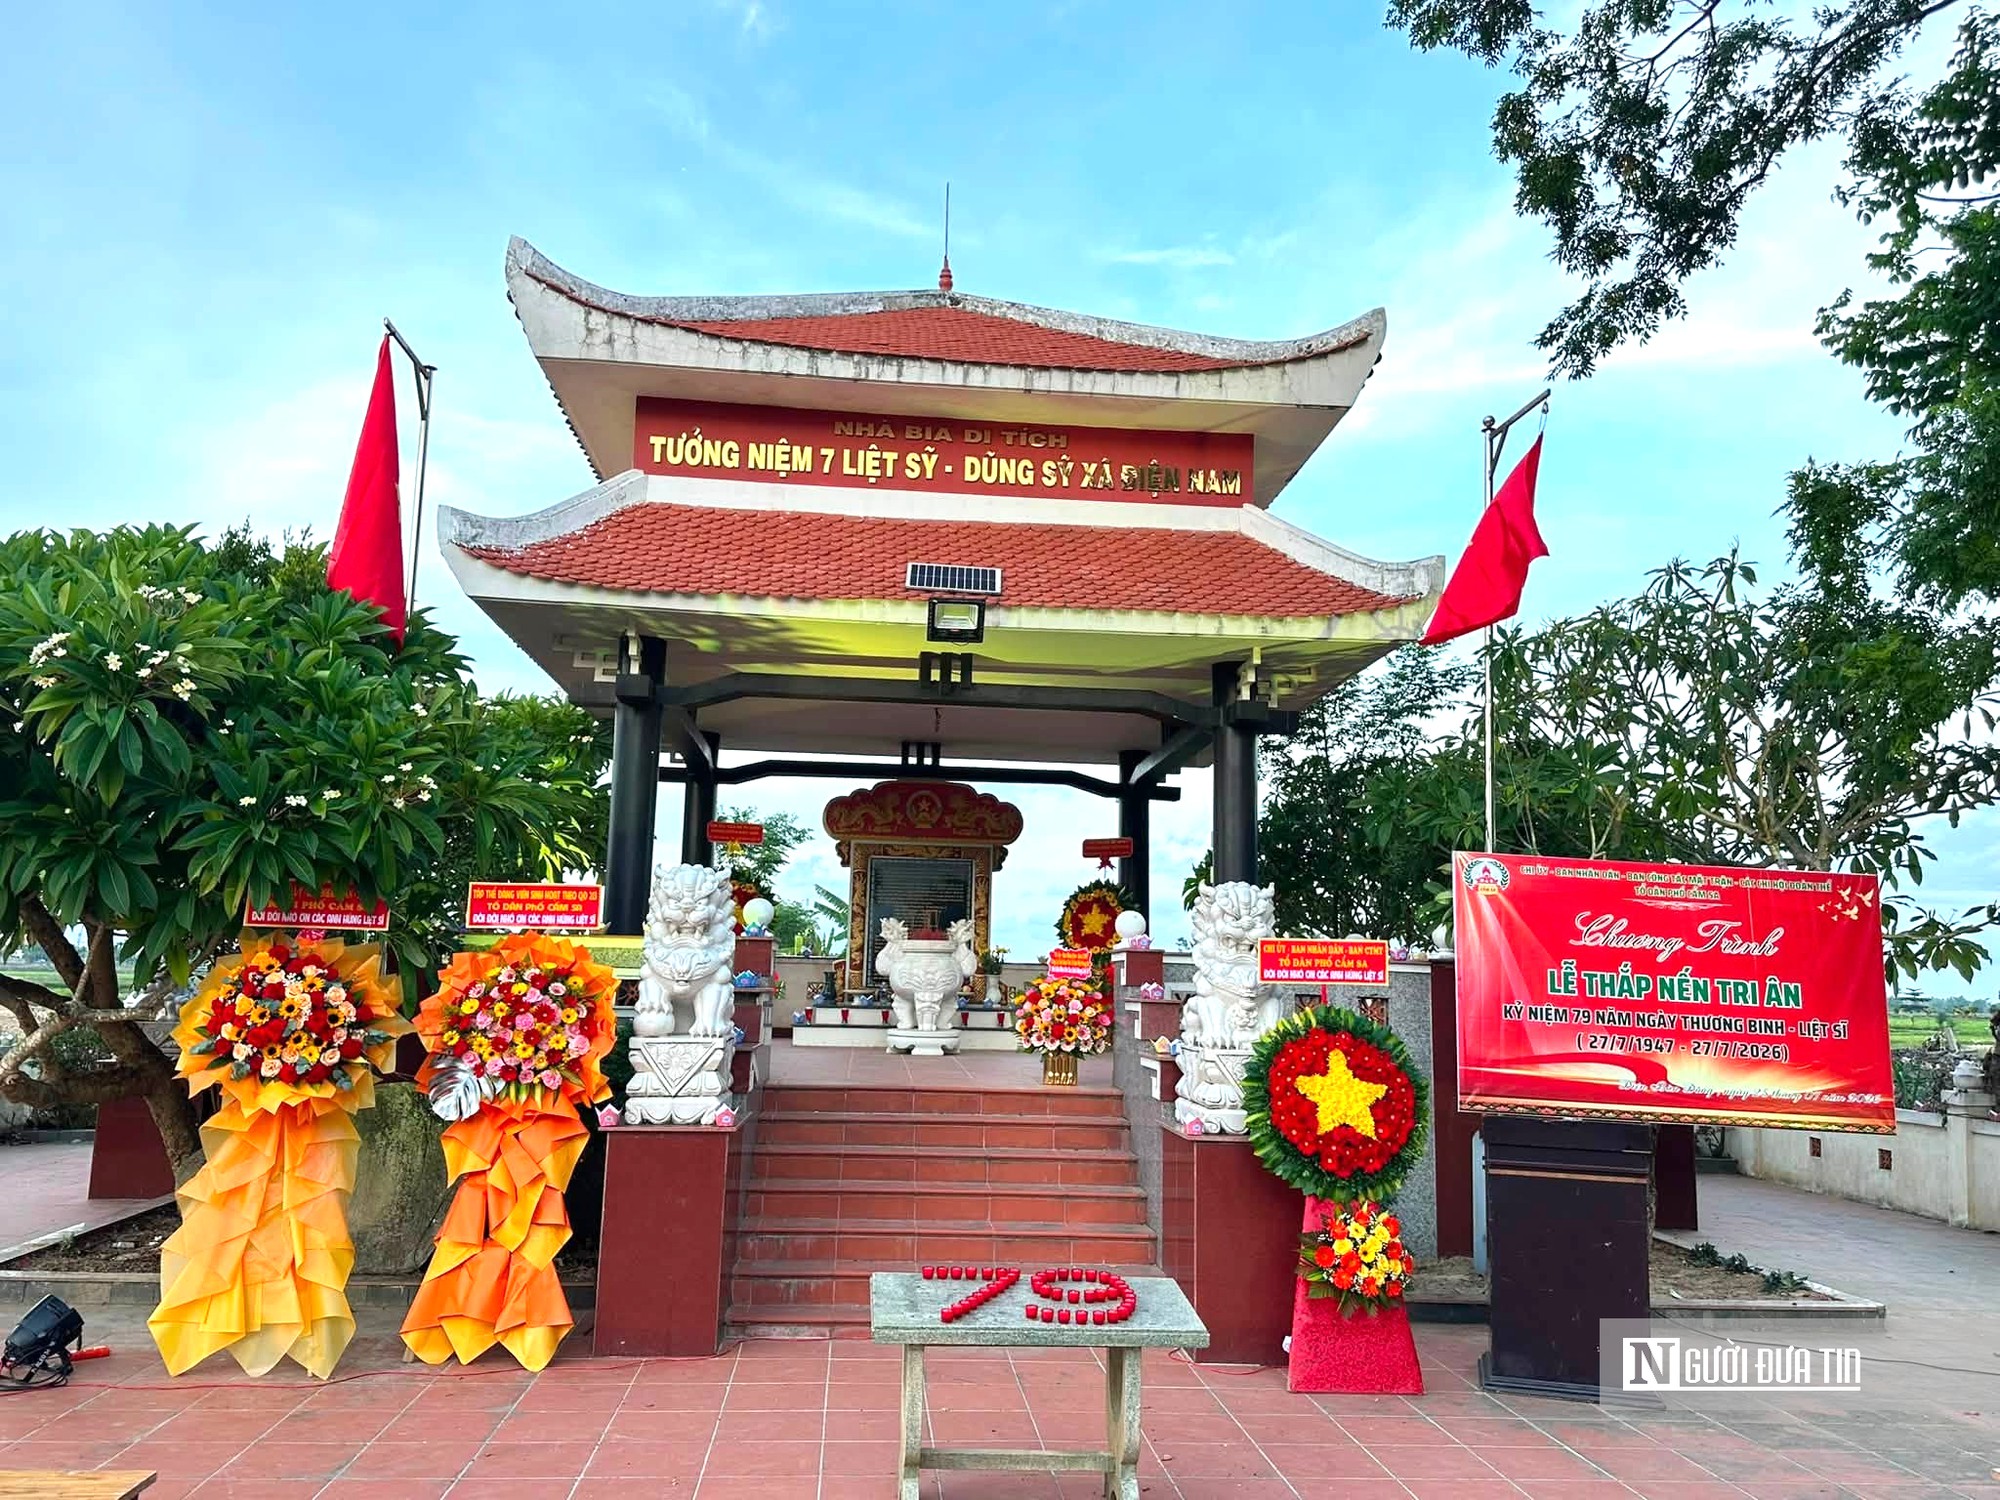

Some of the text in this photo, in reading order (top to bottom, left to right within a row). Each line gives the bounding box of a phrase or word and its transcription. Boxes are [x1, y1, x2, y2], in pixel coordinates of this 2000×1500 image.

[905, 425, 953, 442] BIA
[964, 429, 991, 444] DI
[1002, 428, 1067, 448] TÍCH
[649, 427, 740, 469] TƯỞNG
[748, 438, 813, 477] NIỆM
[820, 448, 835, 474] 7
[843, 444, 898, 483] LIỆT
[905, 446, 939, 480] SỸ
[964, 451, 1034, 486] DŨNG
[1121, 459, 1180, 497] ĐIỆN
[1188, 468, 1241, 495] NAM
[1569, 911, 1784, 962] Chương Trình
[1548, 960, 1802, 1008] LỄ THẮP NẾN TRI ÂN
[1503, 1000, 1524, 1020] KỶ
[1528, 1003, 1568, 1026] NIỆM
[1572, 1008, 1591, 1024] 79
[1595, 1007, 1632, 1026] NĂM
[1635, 1011, 1677, 1029] NGÀY
[1680, 1013, 1743, 1032] THƯƠNG
[1747, 1019, 1785, 1035] BINH
[1798, 1018, 1829, 1042] LIỆT
[1832, 1020, 1848, 1039] SĨ
[1692, 1041, 1789, 1062] 27/7/2026)
